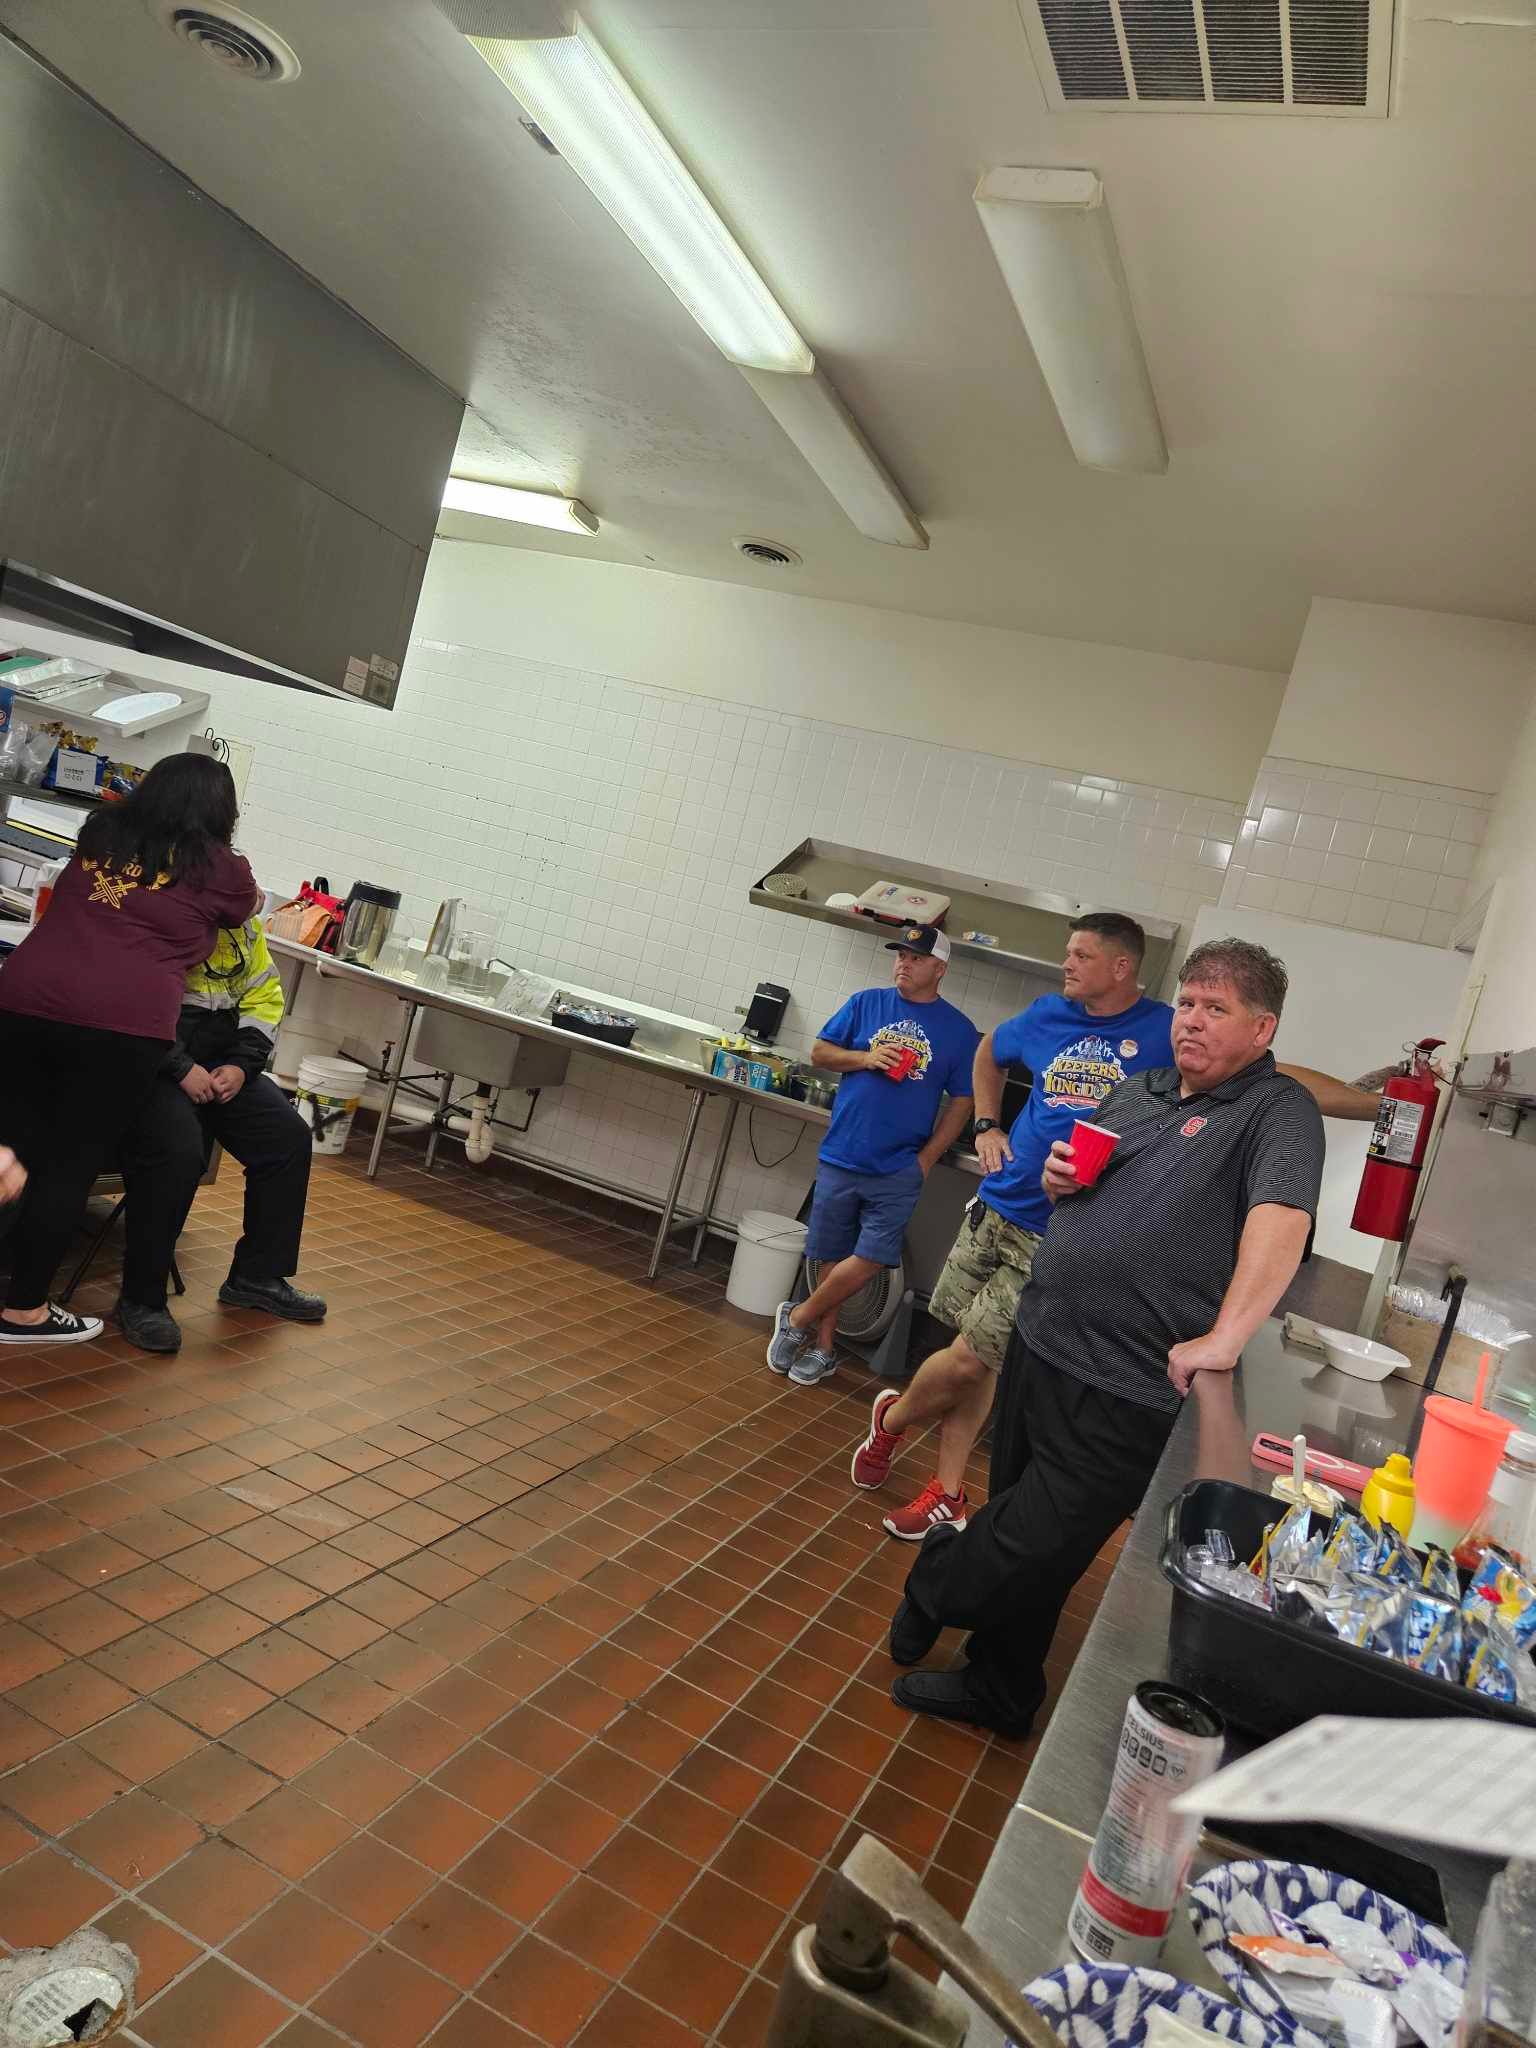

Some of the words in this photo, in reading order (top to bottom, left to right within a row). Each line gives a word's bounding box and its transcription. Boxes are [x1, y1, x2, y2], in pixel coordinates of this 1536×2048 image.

[1053, 1057, 1119, 1081] KEEPERS
[1066, 1072, 1080, 1080] OF
[1081, 1074, 1101, 1083] THE
